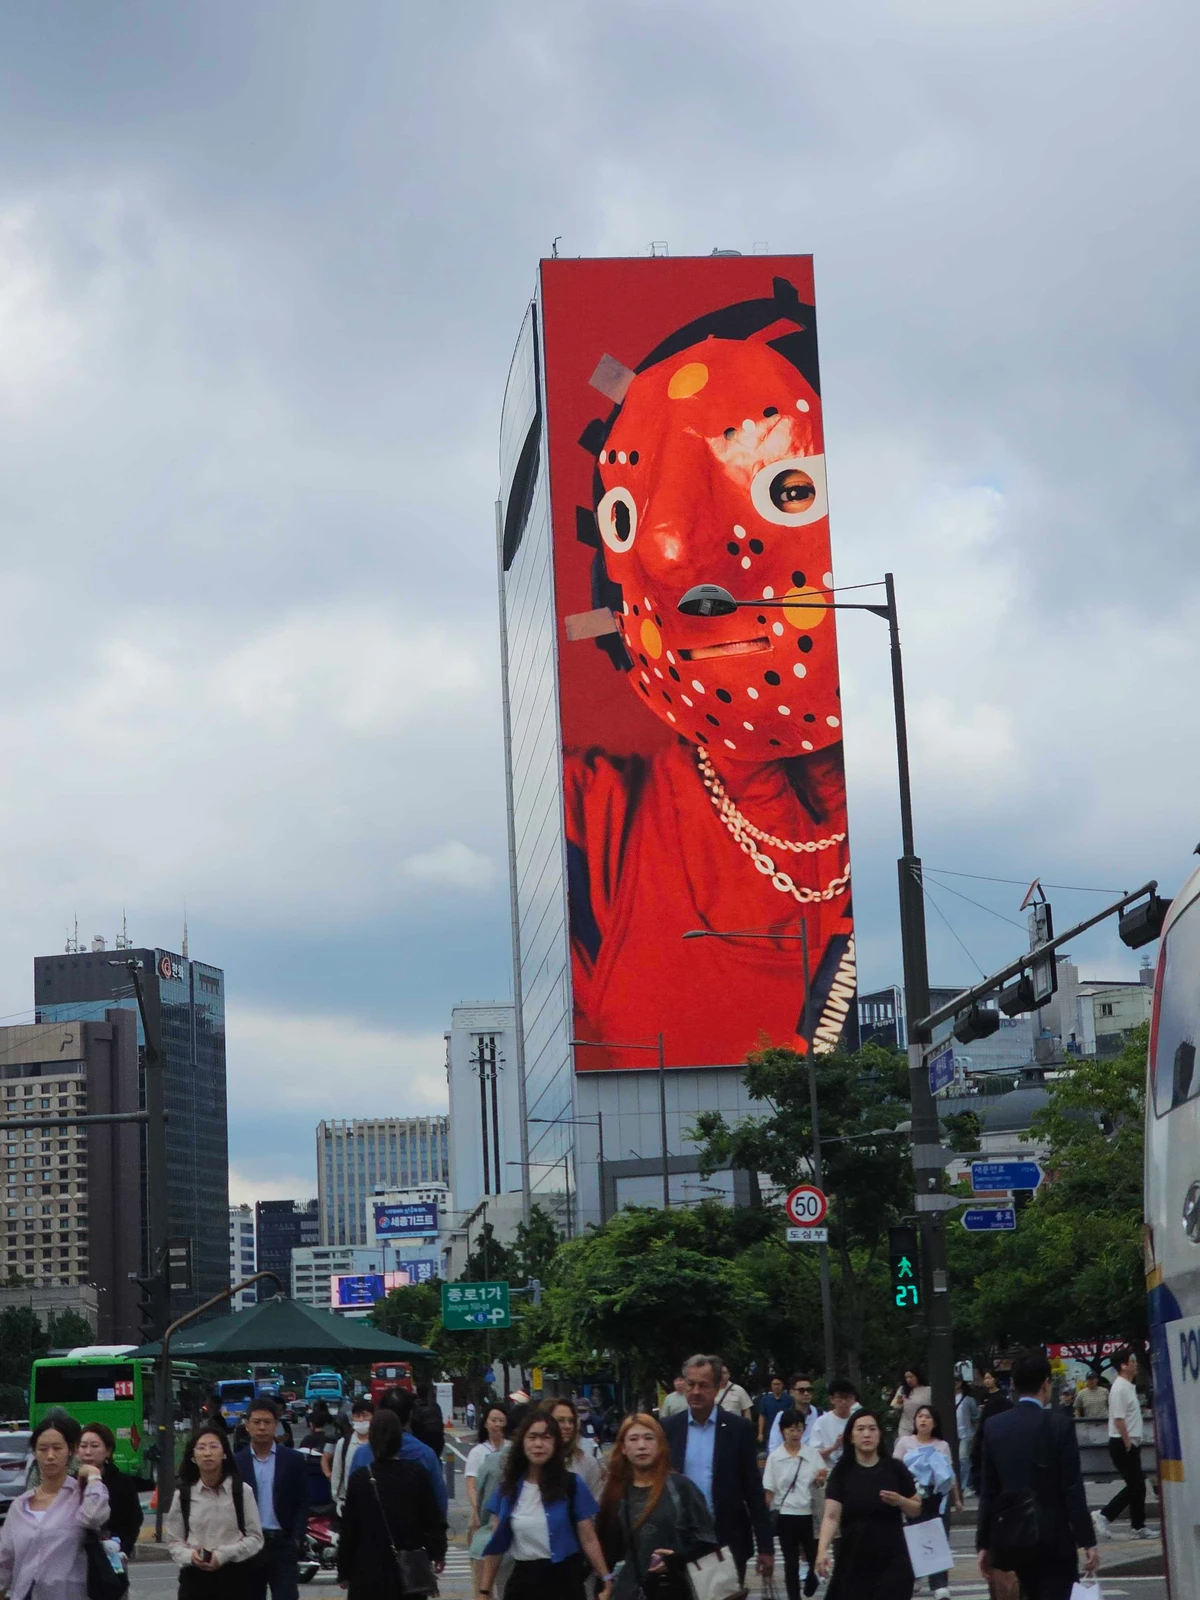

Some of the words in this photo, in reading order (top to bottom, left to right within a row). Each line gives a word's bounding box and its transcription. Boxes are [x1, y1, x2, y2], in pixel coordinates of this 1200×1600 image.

[795, 1196, 818, 1217] 50
[390, 1215, 434, 1227] 세종기프트
[789, 1230, 825, 1240] 도심부
[447, 1286, 502, 1302] 종로1가
[895, 1285, 918, 1307] 27
[477, 1313, 484, 1321] 6
[1180, 1329, 1200, 1383] PO
